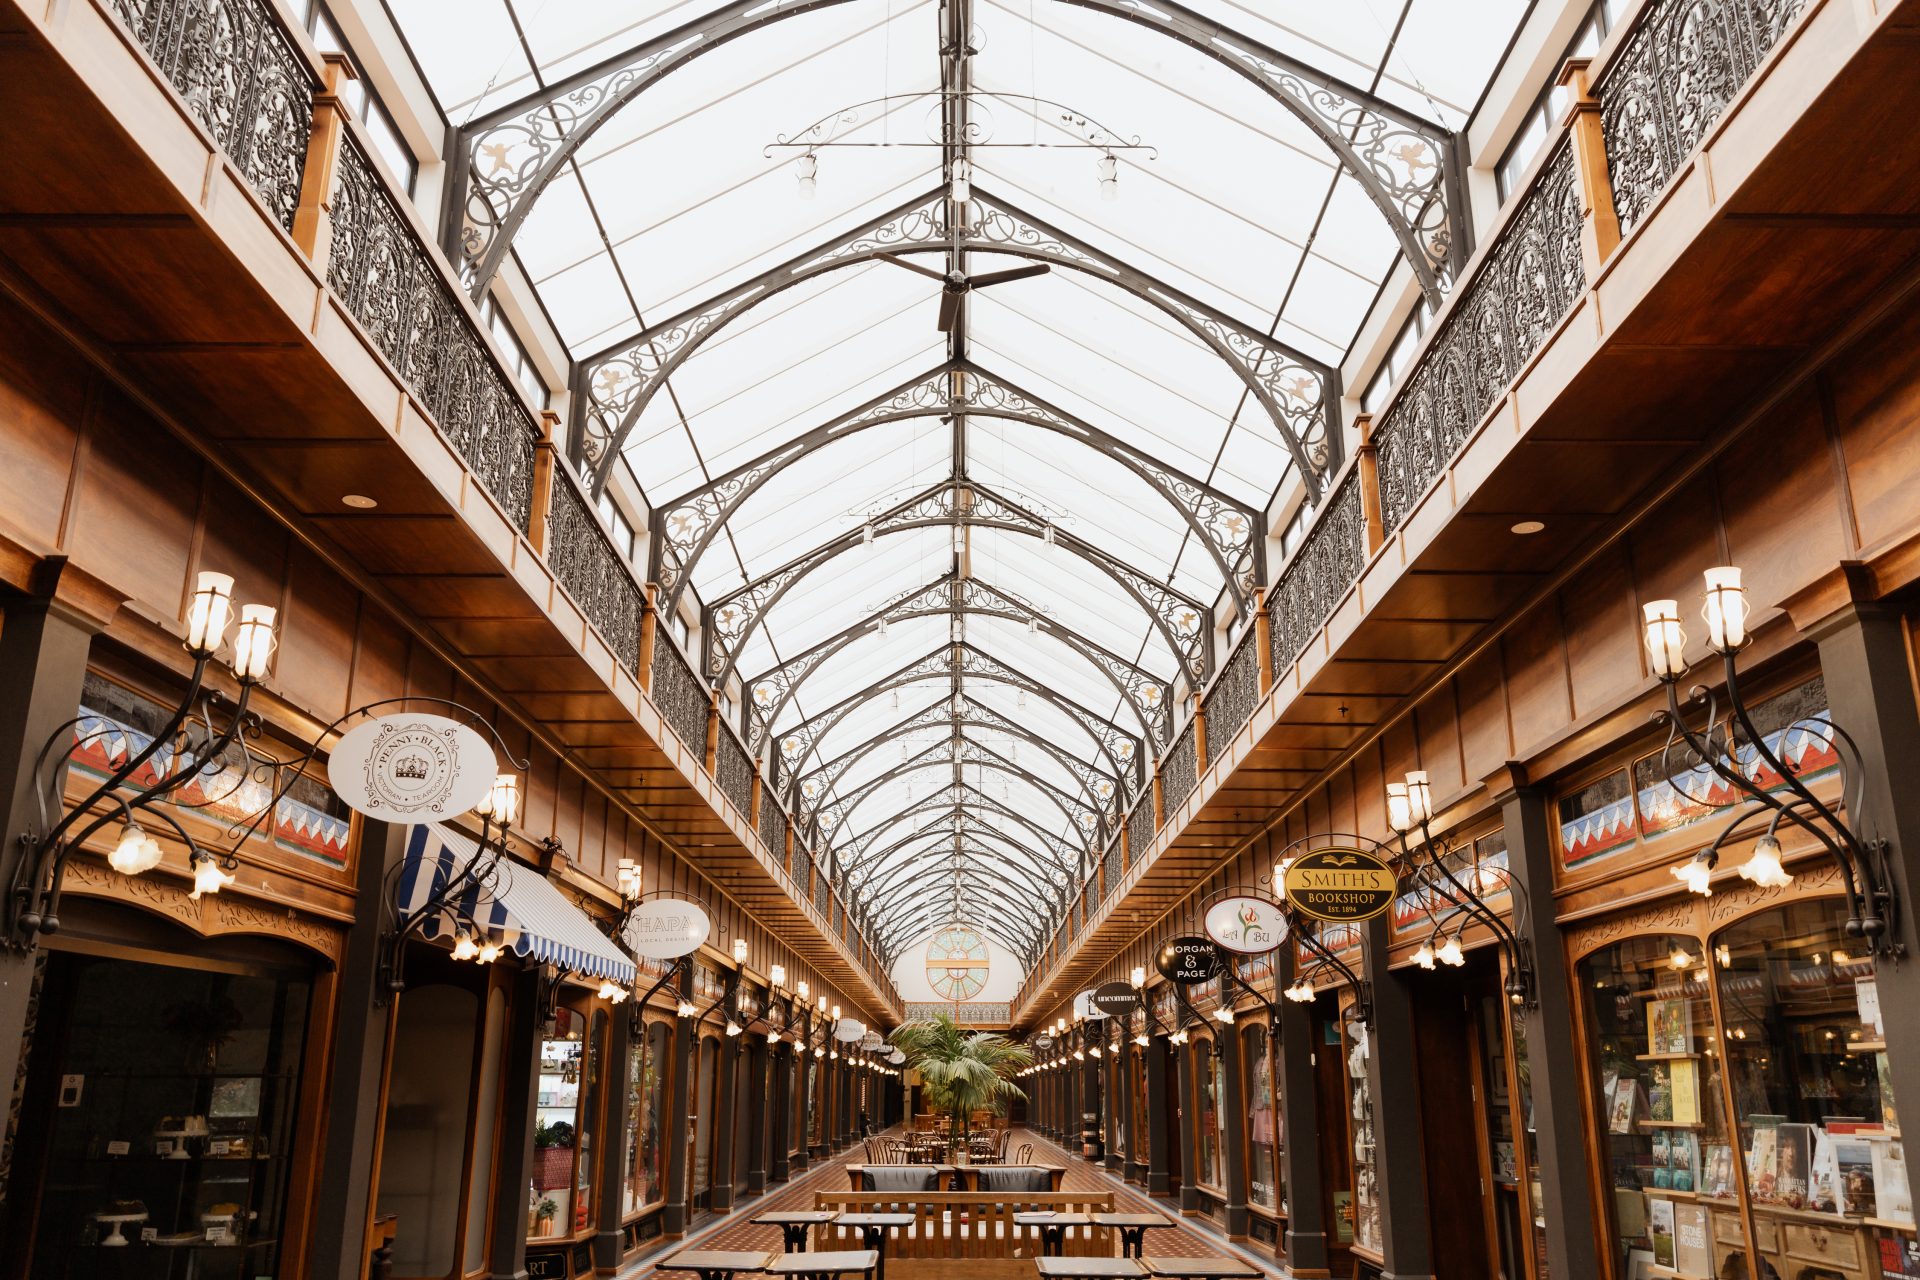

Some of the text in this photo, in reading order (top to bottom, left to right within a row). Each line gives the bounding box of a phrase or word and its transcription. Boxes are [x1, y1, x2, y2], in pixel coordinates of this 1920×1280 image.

[379, 735, 447, 768] PENNY BLACK
[377, 771, 444, 802] VICTORIAN TEAROOM
[1301, 870, 1380, 889] SMITH'S
[1308, 892, 1376, 904] BOOKSHOP
[1342, 905, 1357, 913] 1894
[639, 915, 692, 932] HAPA
[1253, 931, 1270, 943] BU
[1166, 945, 1213, 953] MORGAN
[1185, 954, 1197, 969] &
[1176, 970, 1207, 978] PAGE
[1680, 1224, 1702, 1238] STONE
[1680, 1235, 1705, 1249] HOUSES
[528, 1261, 548, 1275] RT
